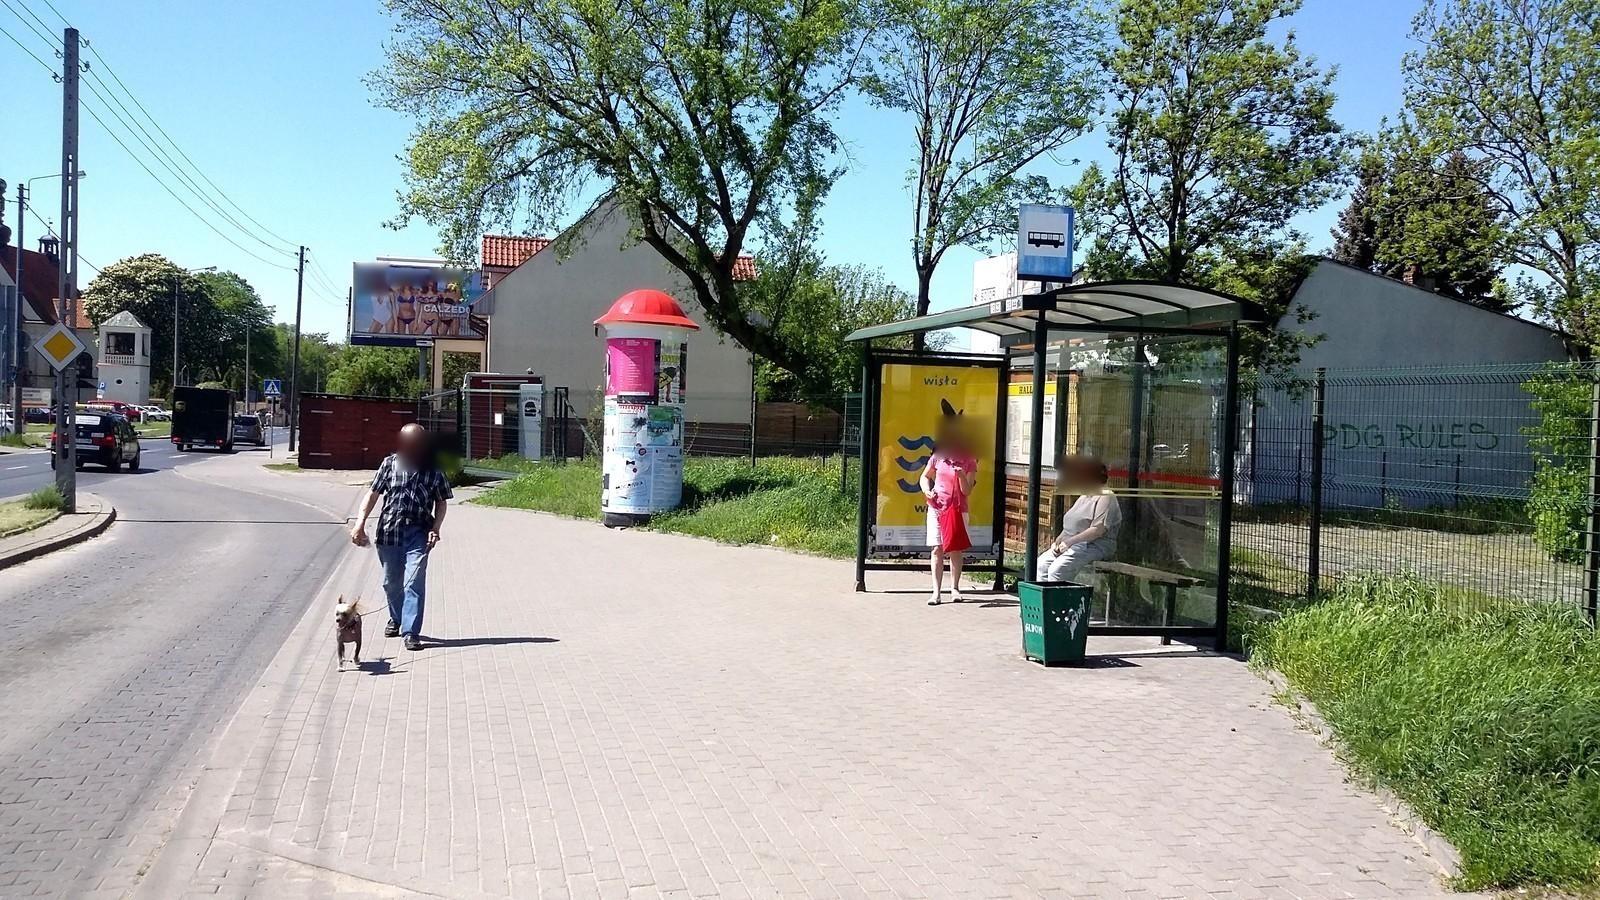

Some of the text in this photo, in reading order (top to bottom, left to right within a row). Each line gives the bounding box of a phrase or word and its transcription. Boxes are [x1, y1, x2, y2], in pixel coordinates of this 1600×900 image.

[423, 303, 471, 314] CALZEDO
[923, 375, 958, 386] wisła
[1018, 385, 1034, 395] HALL
[1396, 422, 1499, 450] RULES
